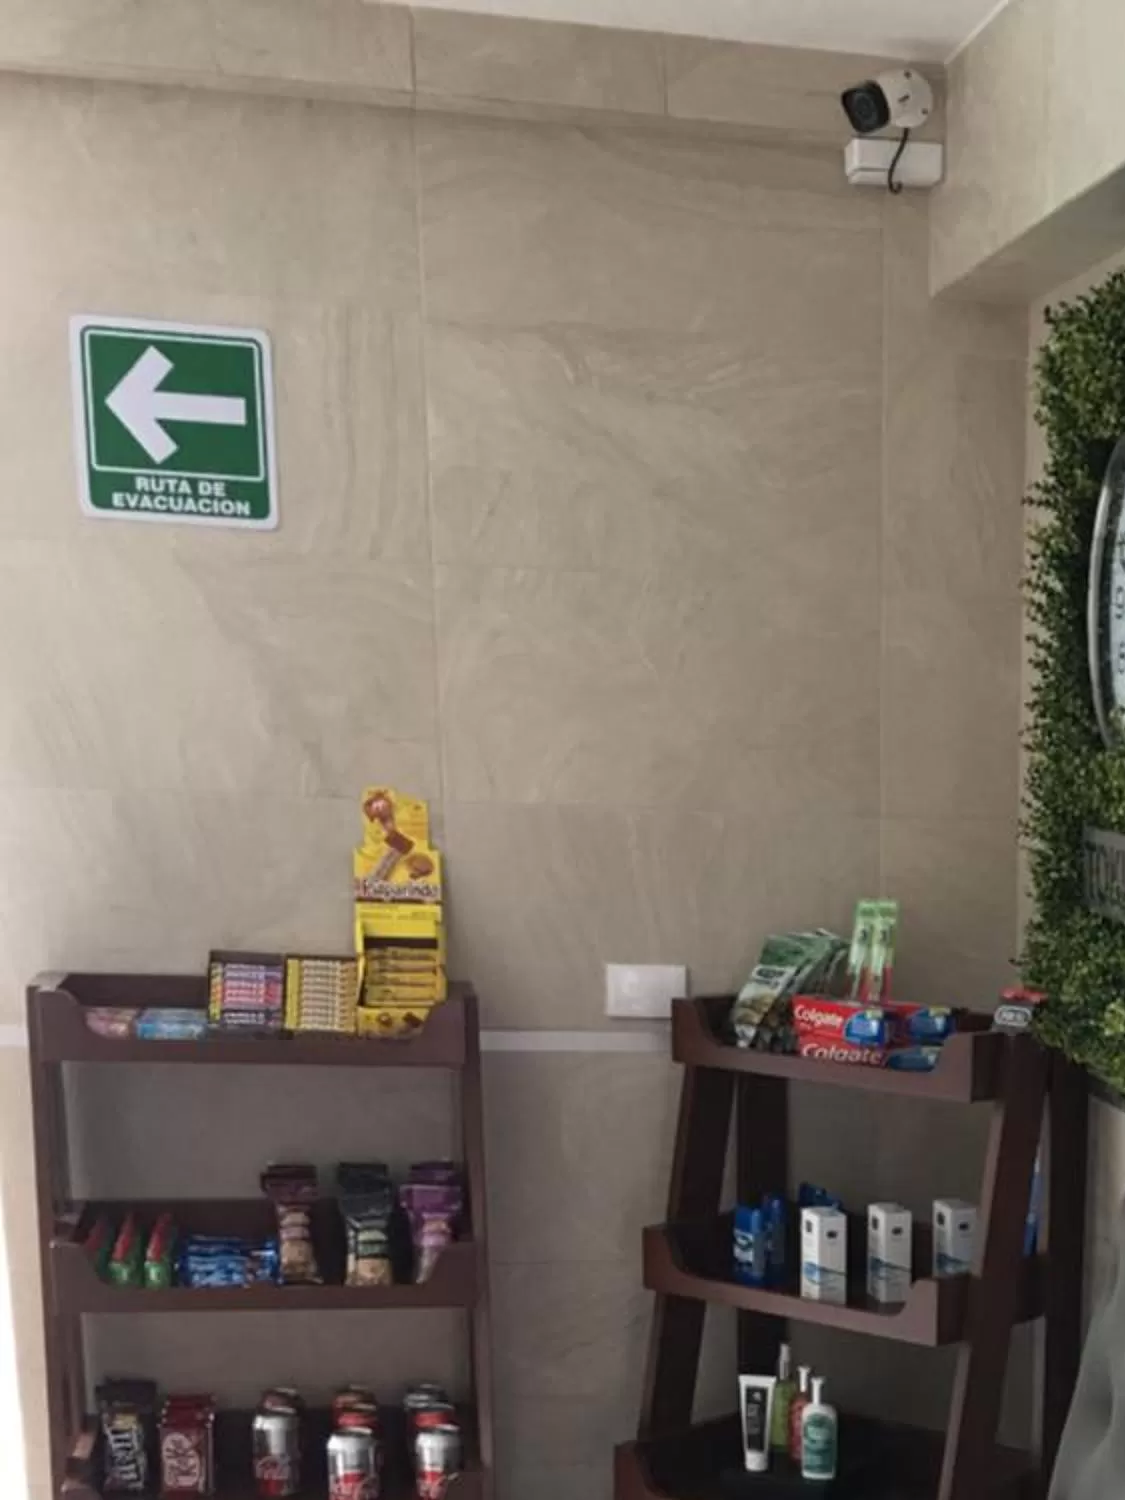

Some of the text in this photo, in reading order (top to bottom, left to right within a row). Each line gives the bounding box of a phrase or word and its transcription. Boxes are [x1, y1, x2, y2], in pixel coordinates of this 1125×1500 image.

[135, 475, 226, 497] RUTA DE
[794, 1003, 844, 1028] Colgate
